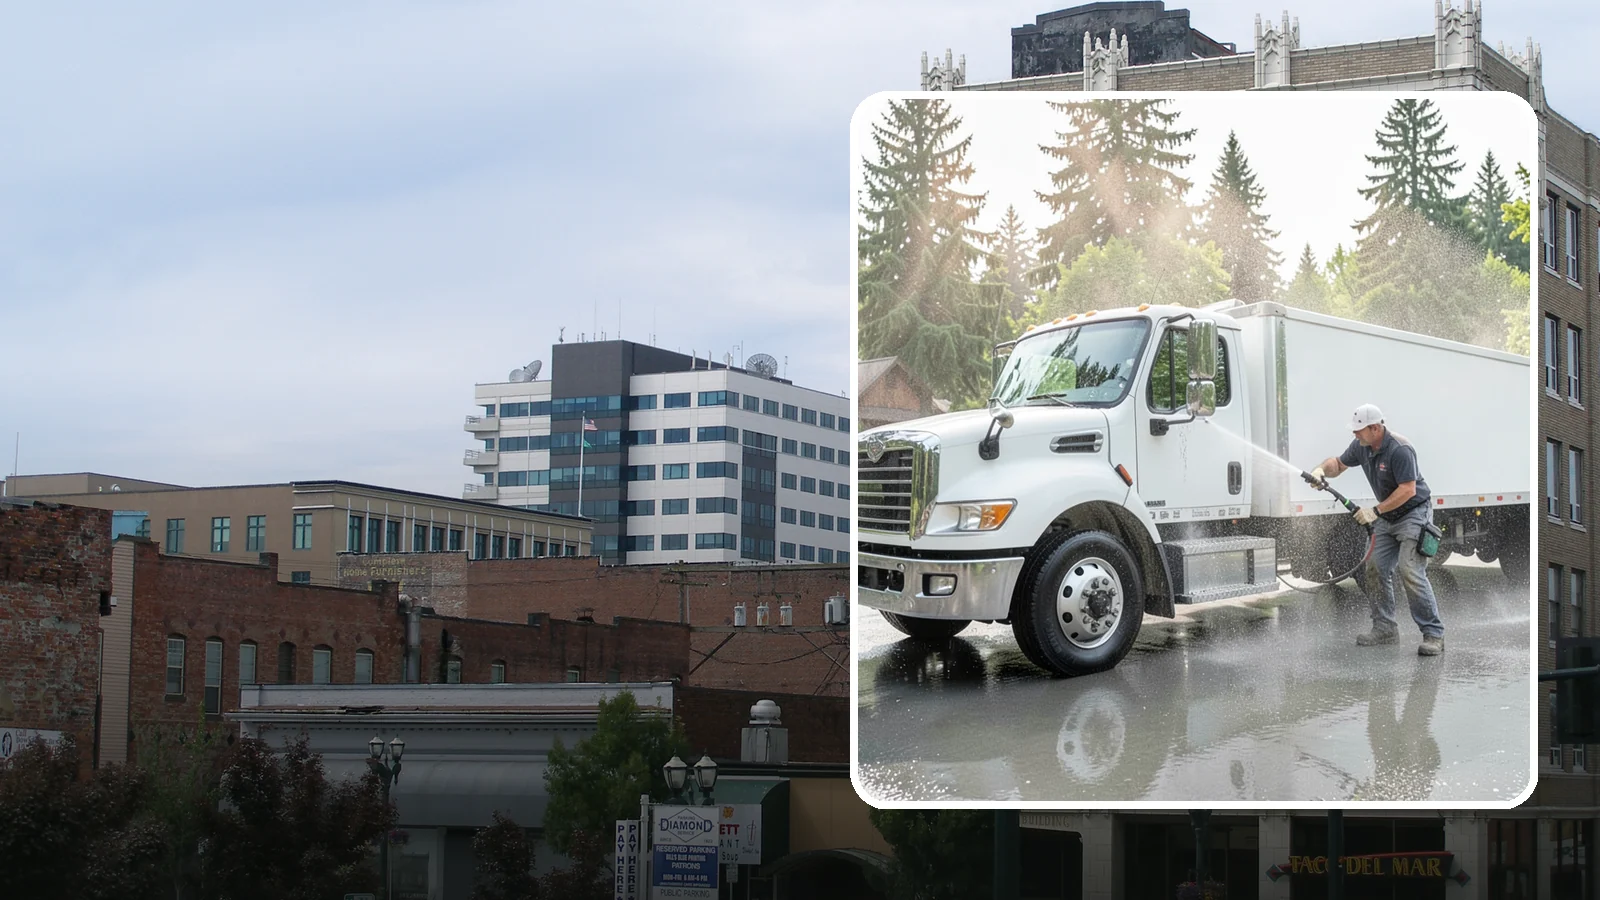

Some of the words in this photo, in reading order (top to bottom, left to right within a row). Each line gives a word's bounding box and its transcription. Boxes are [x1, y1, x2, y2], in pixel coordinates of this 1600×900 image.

[370, 566, 427, 576] Furnishers
[660, 818, 713, 832] DIAMOND
[1022, 815, 1069, 828] BUILDING
[656, 845, 688, 853] RESERVED
[689, 846, 716, 854] PARKING
[671, 862, 701, 870] PATRONS
[1289, 856, 1330, 874] TAC
[1346, 856, 1385, 876] DEL
[1392, 857, 1442, 876] MAR
[617, 856, 625, 893] HERE
[628, 856, 636, 893] HERE
[660, 889, 682, 897] PUBLIC
[683, 889, 710, 898] PARKING
